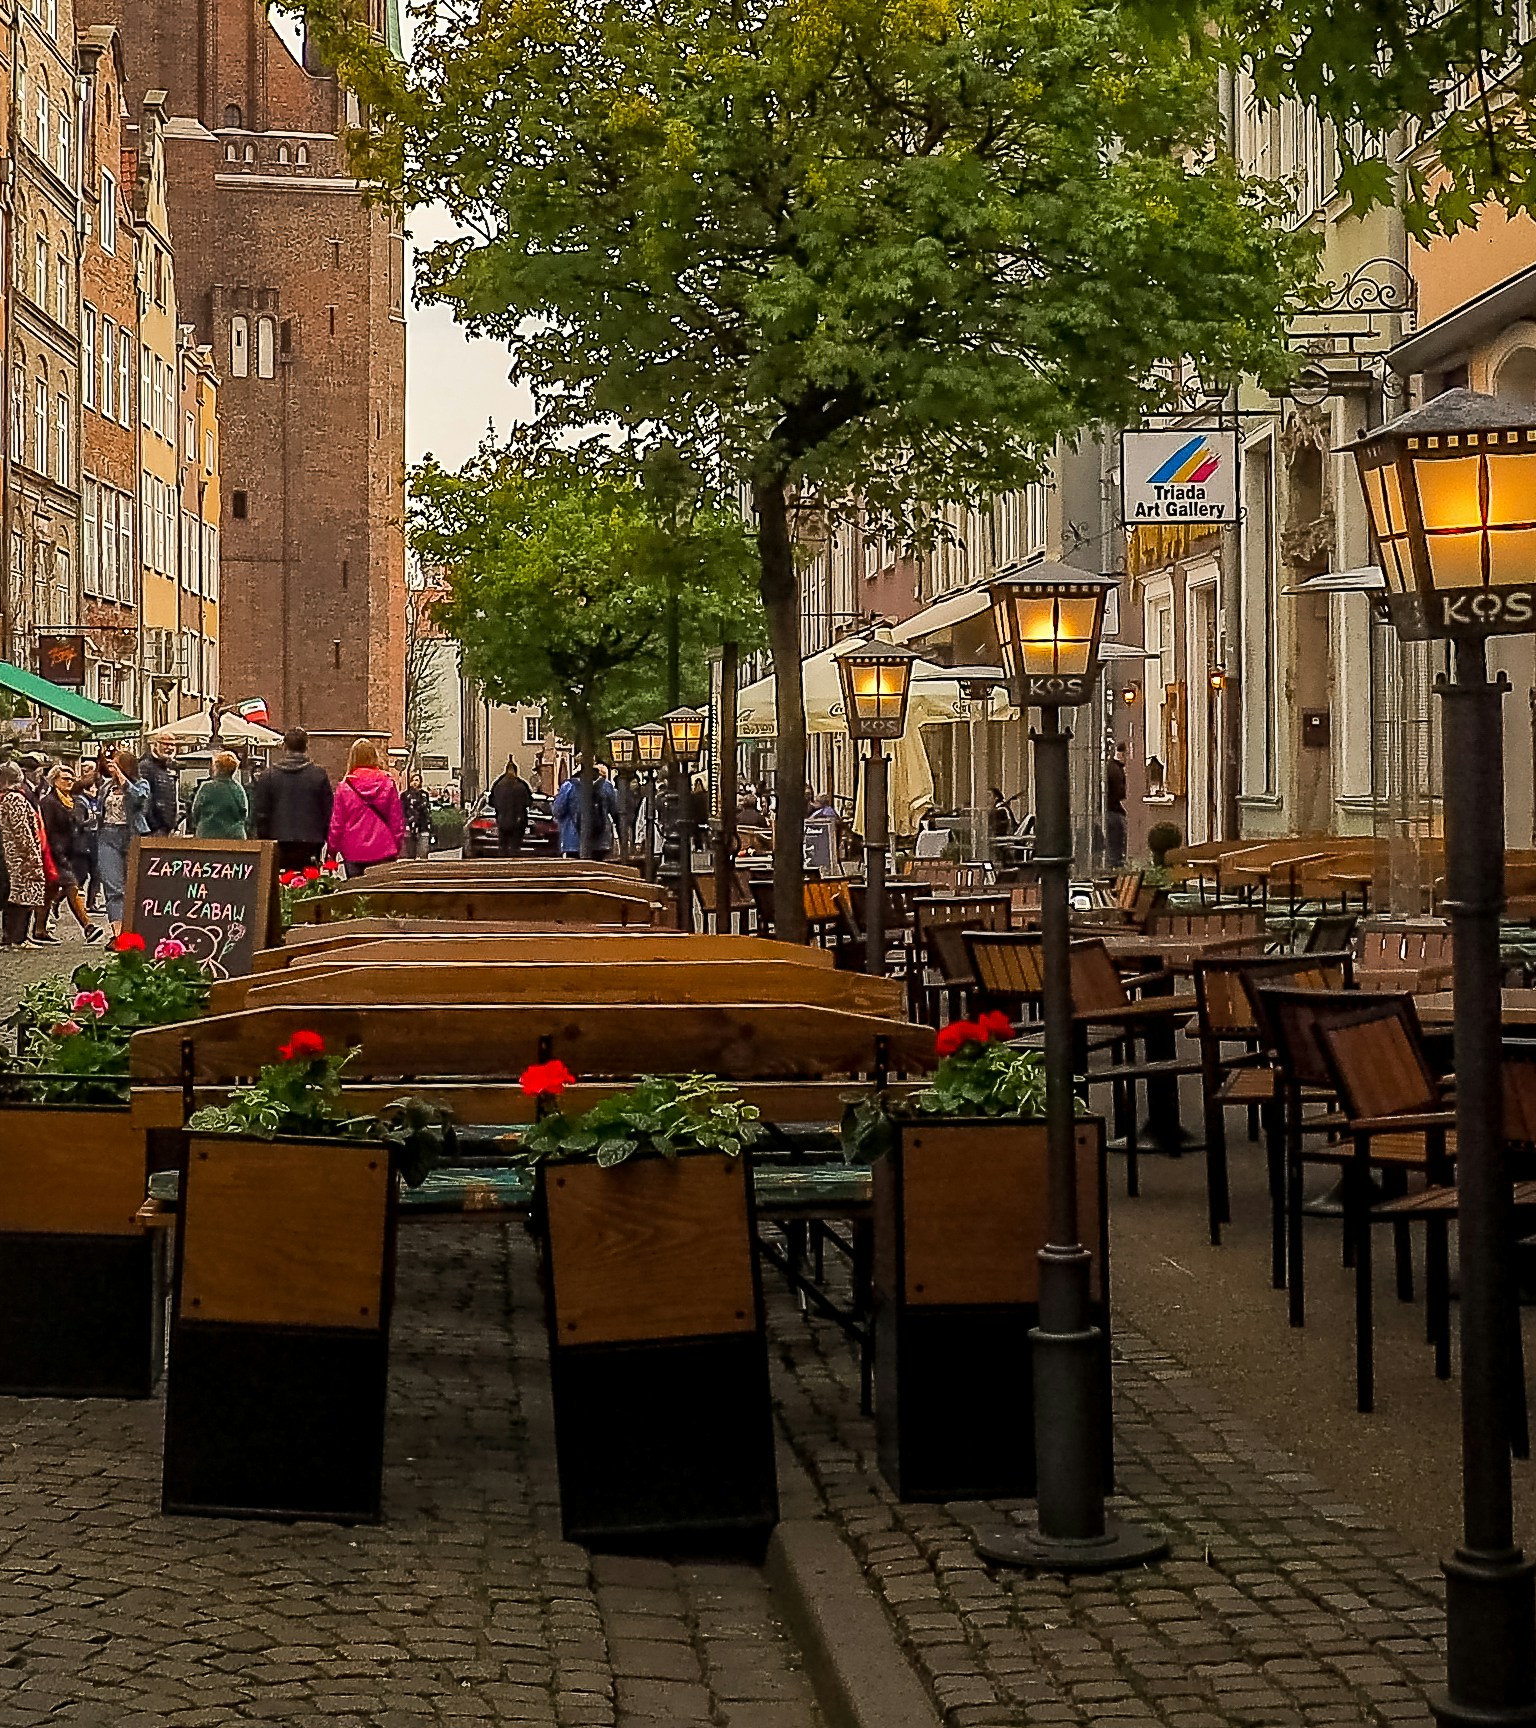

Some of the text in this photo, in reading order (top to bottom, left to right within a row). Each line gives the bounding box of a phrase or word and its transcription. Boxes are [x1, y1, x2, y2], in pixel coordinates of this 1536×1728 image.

[1154, 485, 1206, 501] Triada
[1135, 502, 1225, 519] Art Gallery
[1443, 592, 1533, 625] KOS
[1030, 678, 1083, 695] KOS
[147, 857, 254, 880] ZAPRASZAMY
[187, 883, 208, 899] NA
[142, 899, 246, 922] PLAC ZABAW
